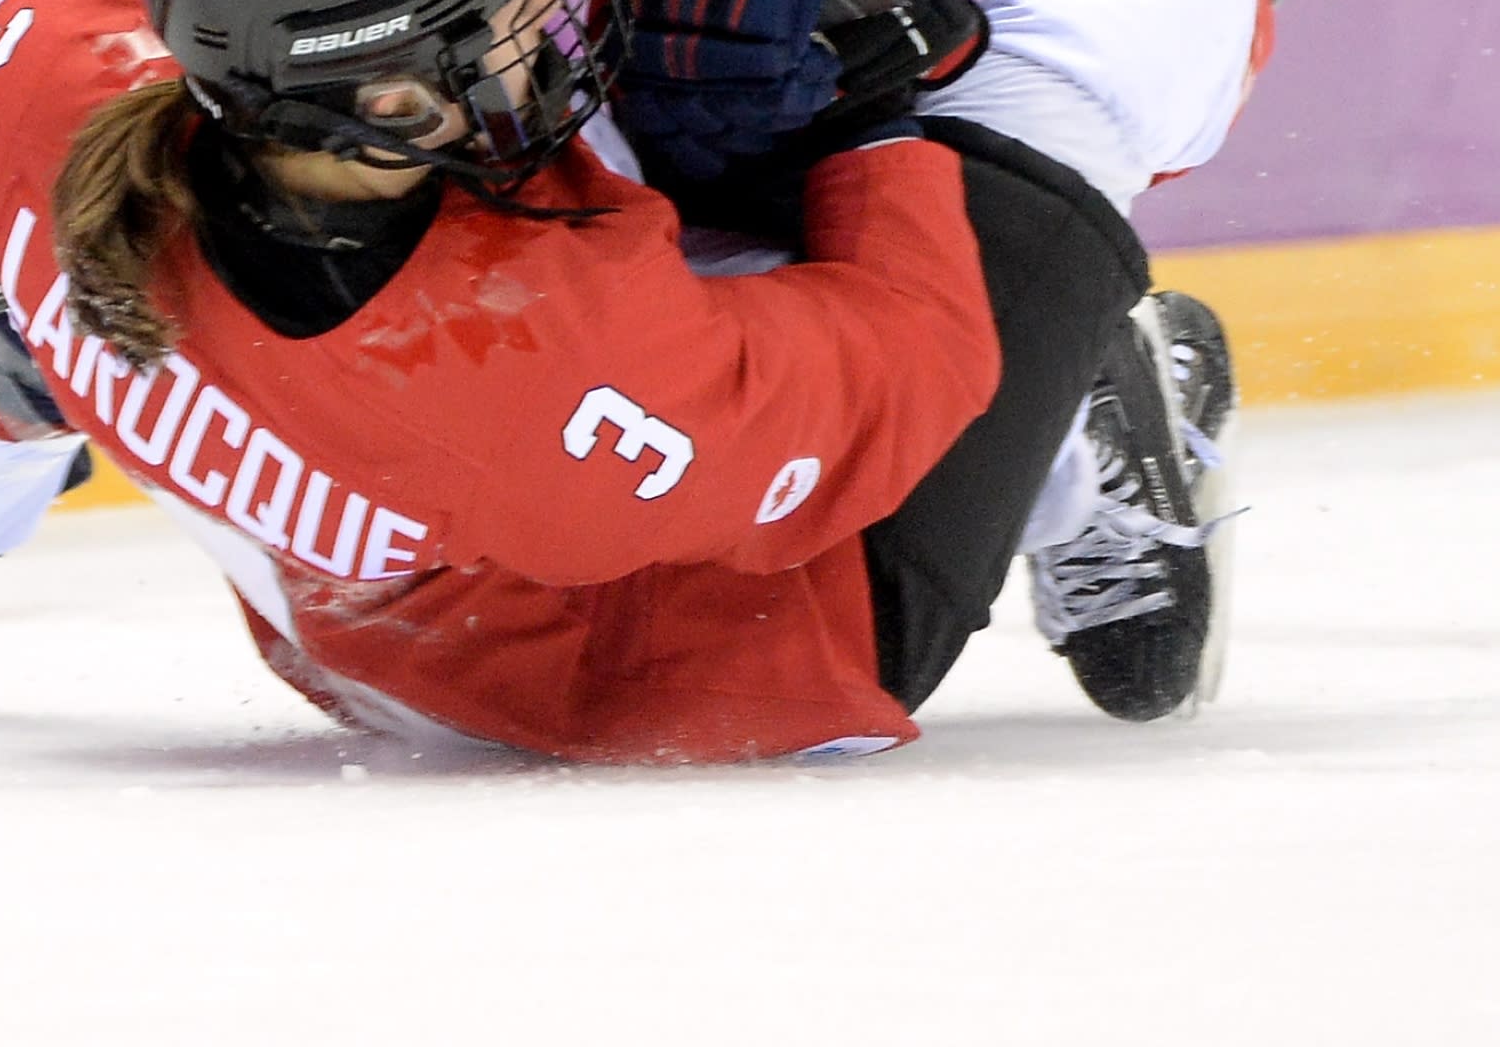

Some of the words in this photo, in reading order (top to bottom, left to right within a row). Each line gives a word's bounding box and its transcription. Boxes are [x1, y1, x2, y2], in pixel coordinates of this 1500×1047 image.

[288, 13, 415, 58] BAUER
[0, 205, 428, 582] LAROCQUE
[562, 383, 695, 500] 3
